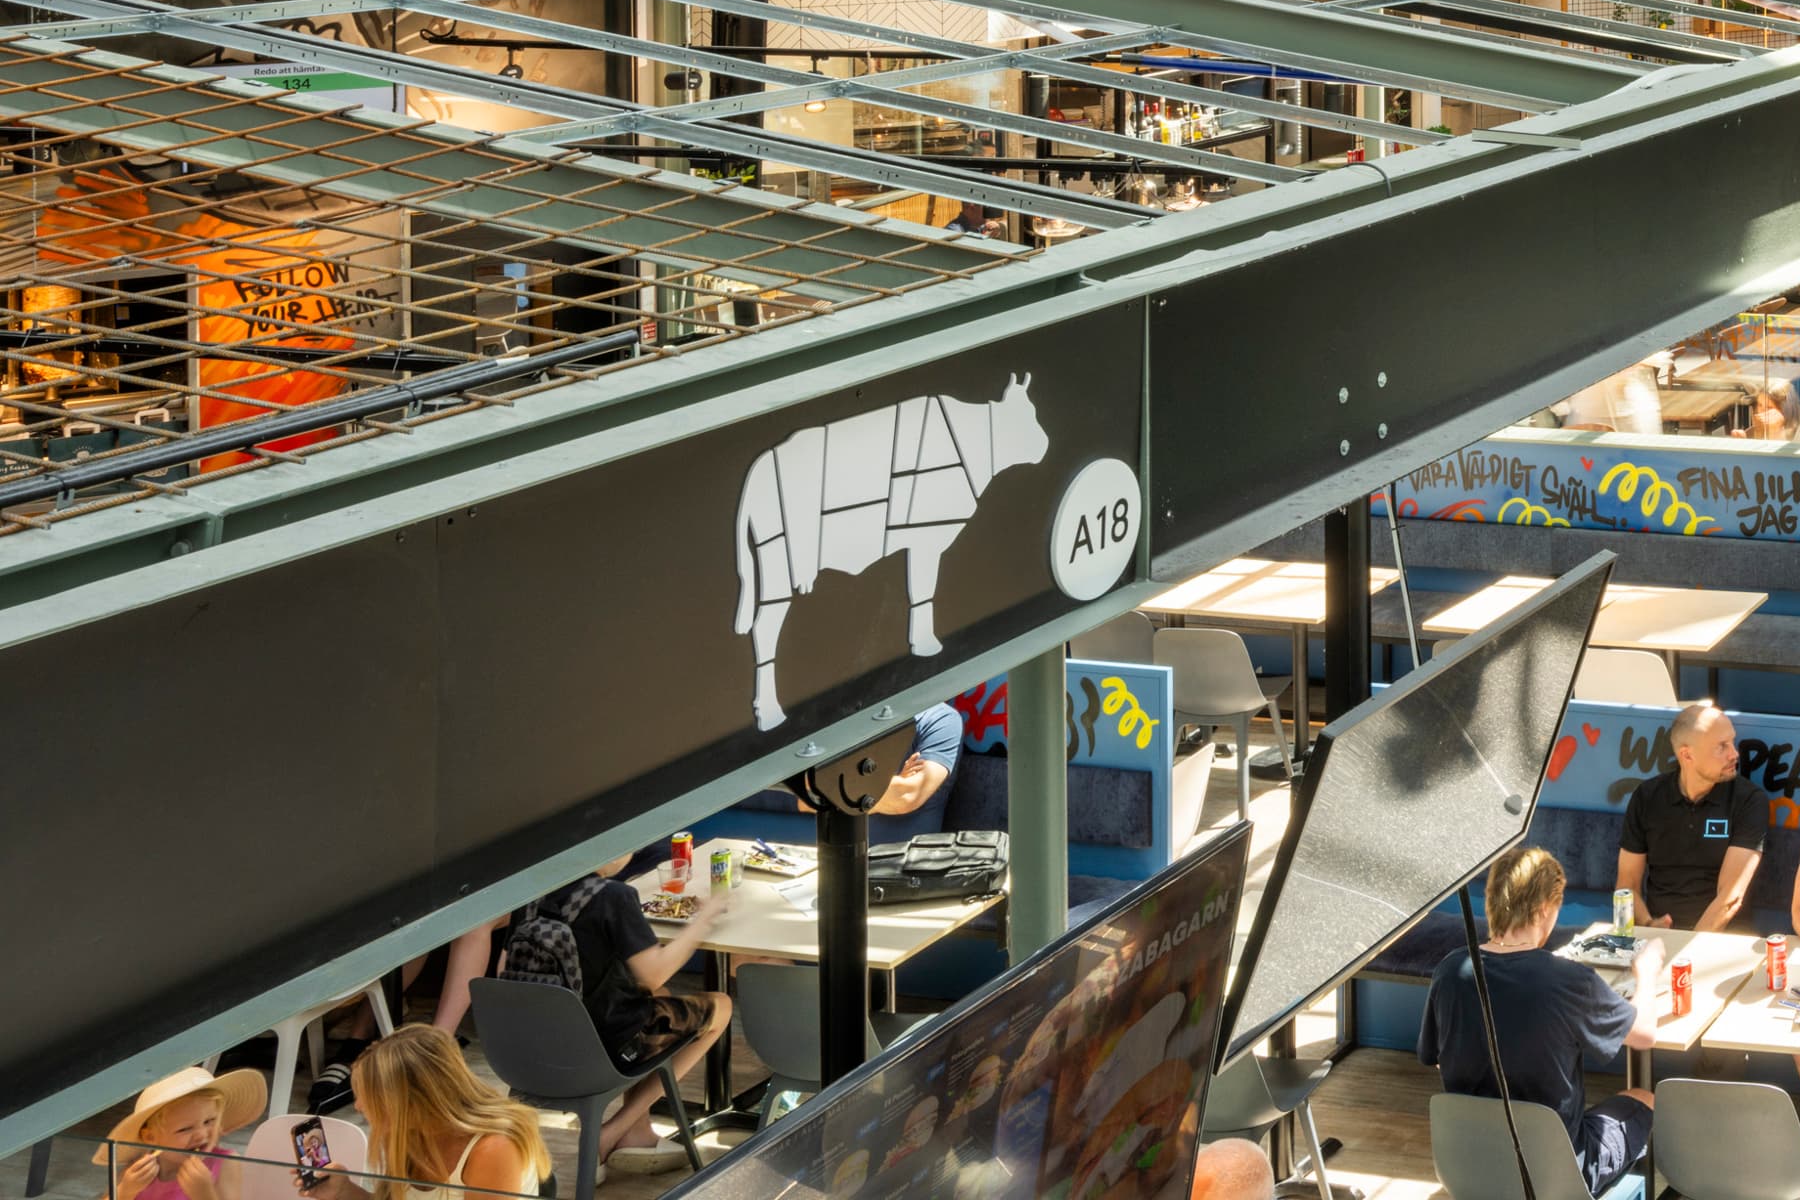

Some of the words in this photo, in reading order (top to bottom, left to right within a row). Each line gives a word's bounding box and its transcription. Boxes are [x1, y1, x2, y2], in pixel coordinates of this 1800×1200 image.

[254, 67, 276, 76] Redo
[278, 66, 292, 75] att
[282, 78, 311, 91] 134
[233, 260, 349, 302] FOLLOW
[1409, 459, 1457, 494] VARA
[1677, 466, 1749, 501] FINA
[1069, 498, 1128, 564] A18
[1737, 504, 1798, 537] JAG
